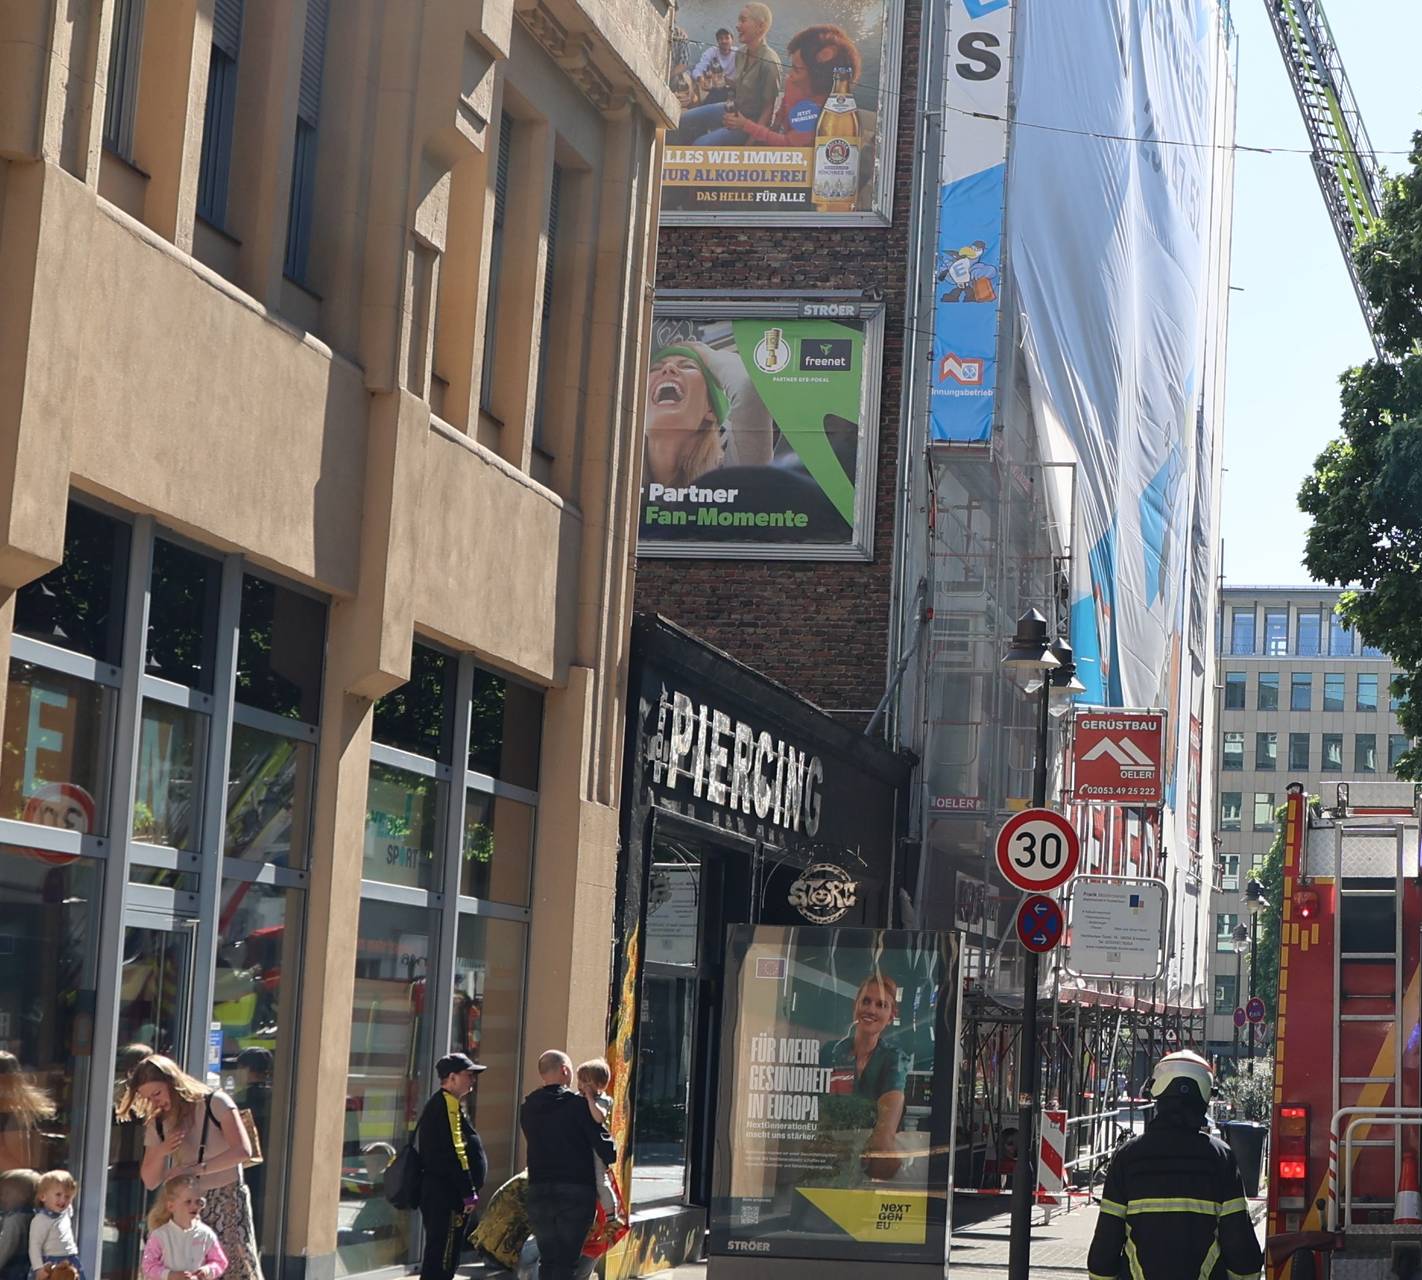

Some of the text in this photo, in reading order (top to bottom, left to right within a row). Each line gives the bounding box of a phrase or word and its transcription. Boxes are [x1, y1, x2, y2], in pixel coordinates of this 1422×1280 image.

[955, 32, 1001, 81] S
[663, 150, 704, 164] LLES
[707, 150, 740, 165] WIE
[743, 151, 808, 166] IMMER,
[693, 168, 807, 182] ALKOHOLFREI
[696, 189, 806, 202] DAS HELLE FÜR ALLE
[803, 304, 855, 316] STRÖER
[805, 356, 846, 366] freenet
[931, 387, 994, 397] Innungsbetrieb
[649, 483, 739, 503] Partner
[645, 506, 809, 527] Fan-Momente
[1081, 719, 1157, 731] GERÜSTBAU
[666, 690, 824, 838] PIERCING
[1120, 771, 1152, 779] OELER
[1140, 787, 1156, 795] 222
[936, 799, 974, 808] OELER
[1014, 831, 1062, 870] 30
[751, 1032, 821, 1064] FÜR MEHR
[749, 1064, 834, 1093] GESUNDHEIT
[747, 1092, 819, 1121] IN EUROPA
[745, 1130, 771, 1139] macht
[786, 1132, 817, 1141] stärker.
[875, 1221, 891, 1230] EU
[727, 1240, 771, 1252] STRÖER
